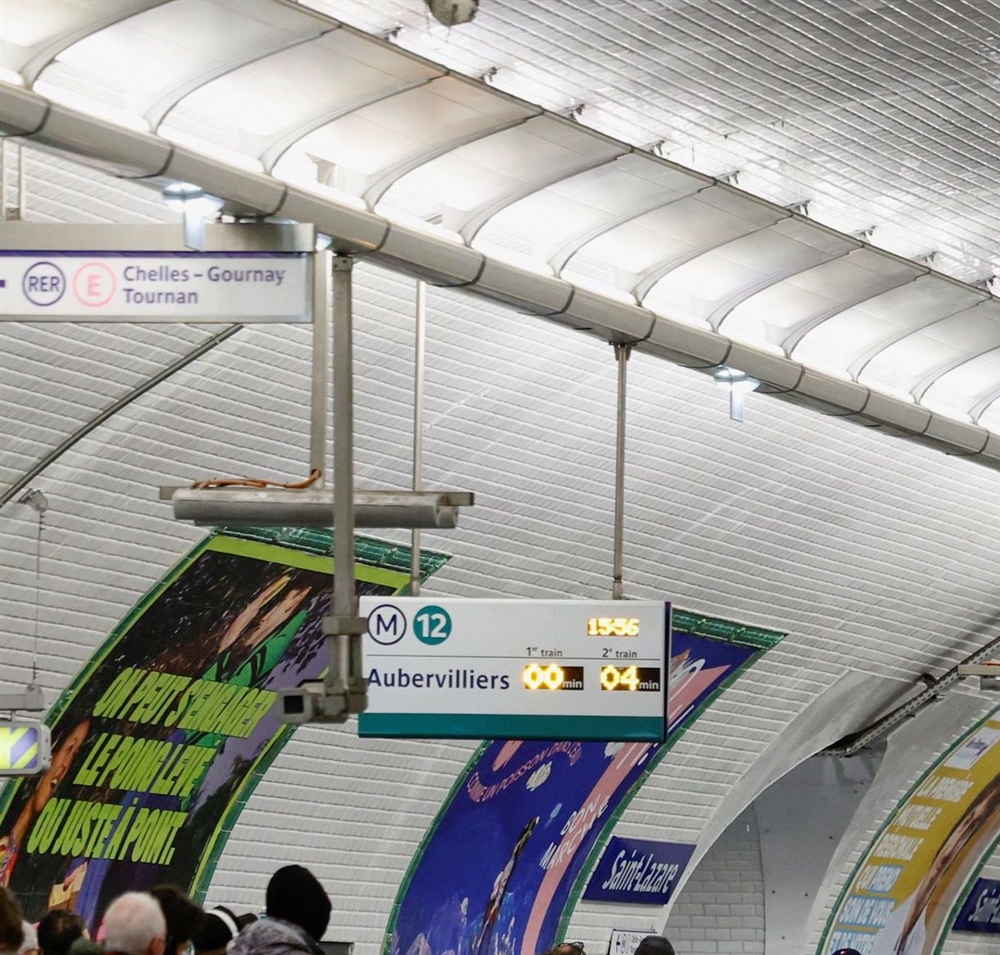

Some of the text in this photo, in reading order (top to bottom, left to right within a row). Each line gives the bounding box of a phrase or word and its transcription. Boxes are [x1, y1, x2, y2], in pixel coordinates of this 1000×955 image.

[28, 277, 60, 292] RER
[87, 275, 101, 296] E
[124, 266, 189, 282] Chelles
[208, 267, 285, 286] Gournay
[123, 289, 198, 305] Tournan
[377, 614, 397, 637] M
[417, 613, 446, 638] 12
[541, 649, 563, 657] train
[615, 650, 637, 658] train
[368, 668, 510, 690] Aubervilliers
[523, 664, 583, 689] 00 min
[600, 665, 659, 690] 04 min
[117, 671, 192, 725] PEUT
[73, 733, 122, 785] LE
[97, 737, 172, 792] POING
[27, 797, 71, 854] OU
[51, 801, 123, 858] JUSTE
[602, 849, 679, 893] Saint-Lazare
